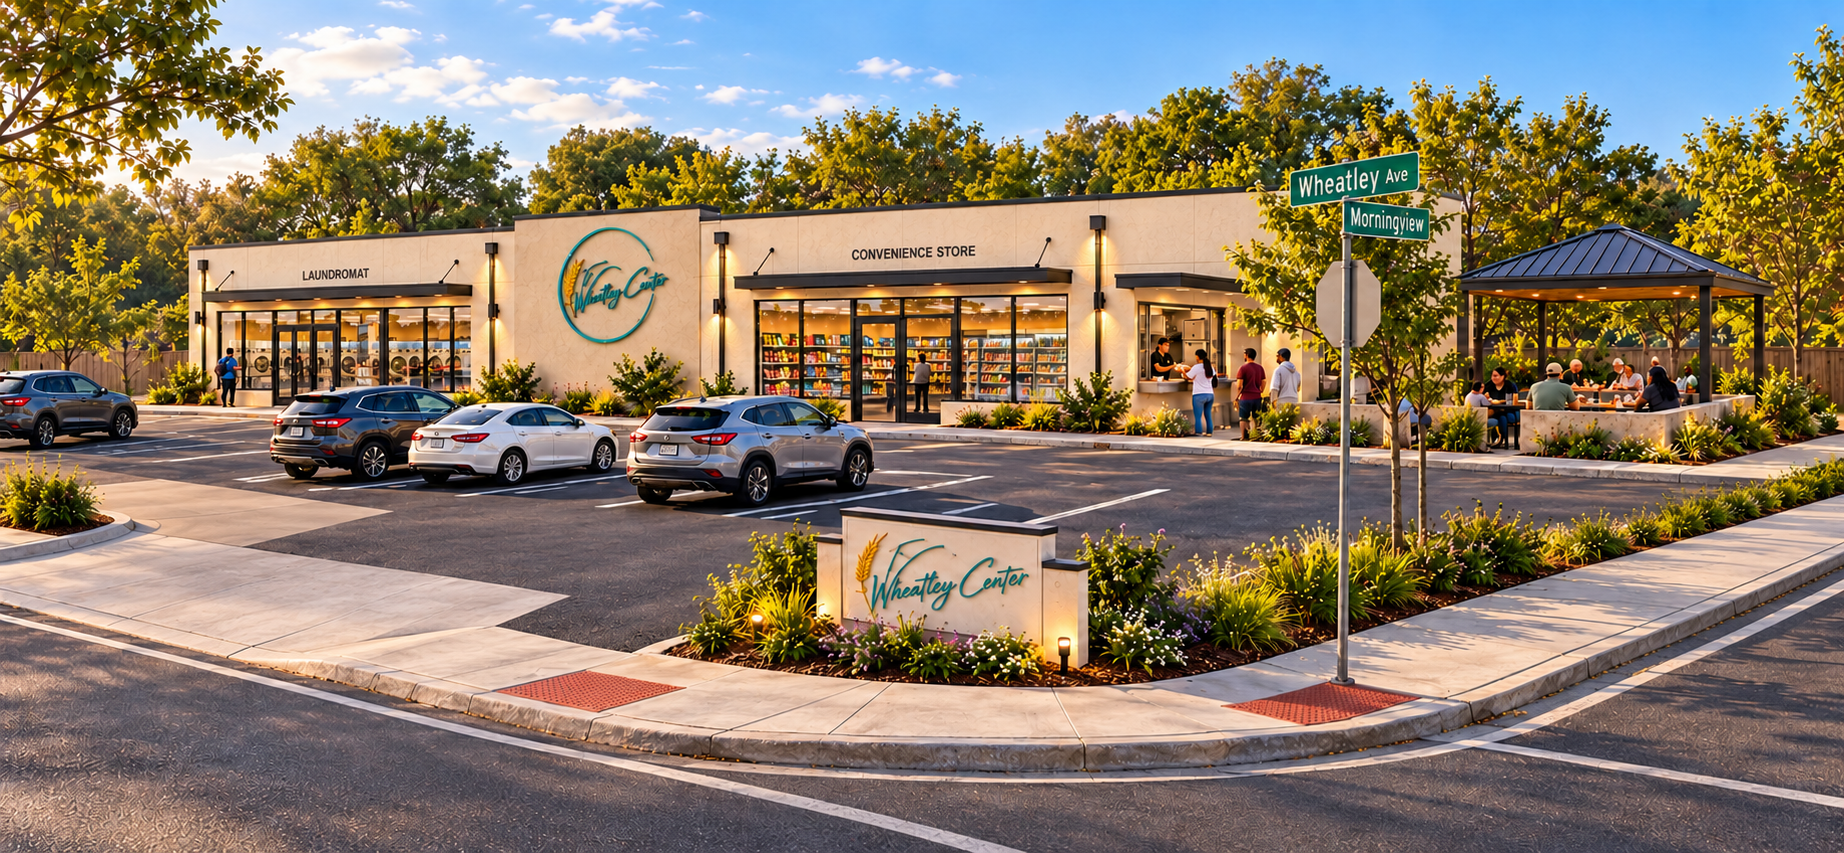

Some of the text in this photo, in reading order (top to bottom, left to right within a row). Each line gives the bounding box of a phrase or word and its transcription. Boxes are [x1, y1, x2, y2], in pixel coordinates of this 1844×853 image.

[1298, 166, 1408, 198] Wheatley Ave
[1350, 207, 1424, 235] Morningview
[851, 245, 976, 261] CONVENIENCE STORE
[302, 267, 370, 281] LAUNDROMAT
[623, 266, 669, 299] Center
[871, 538, 1029, 611] Wheatley Center
